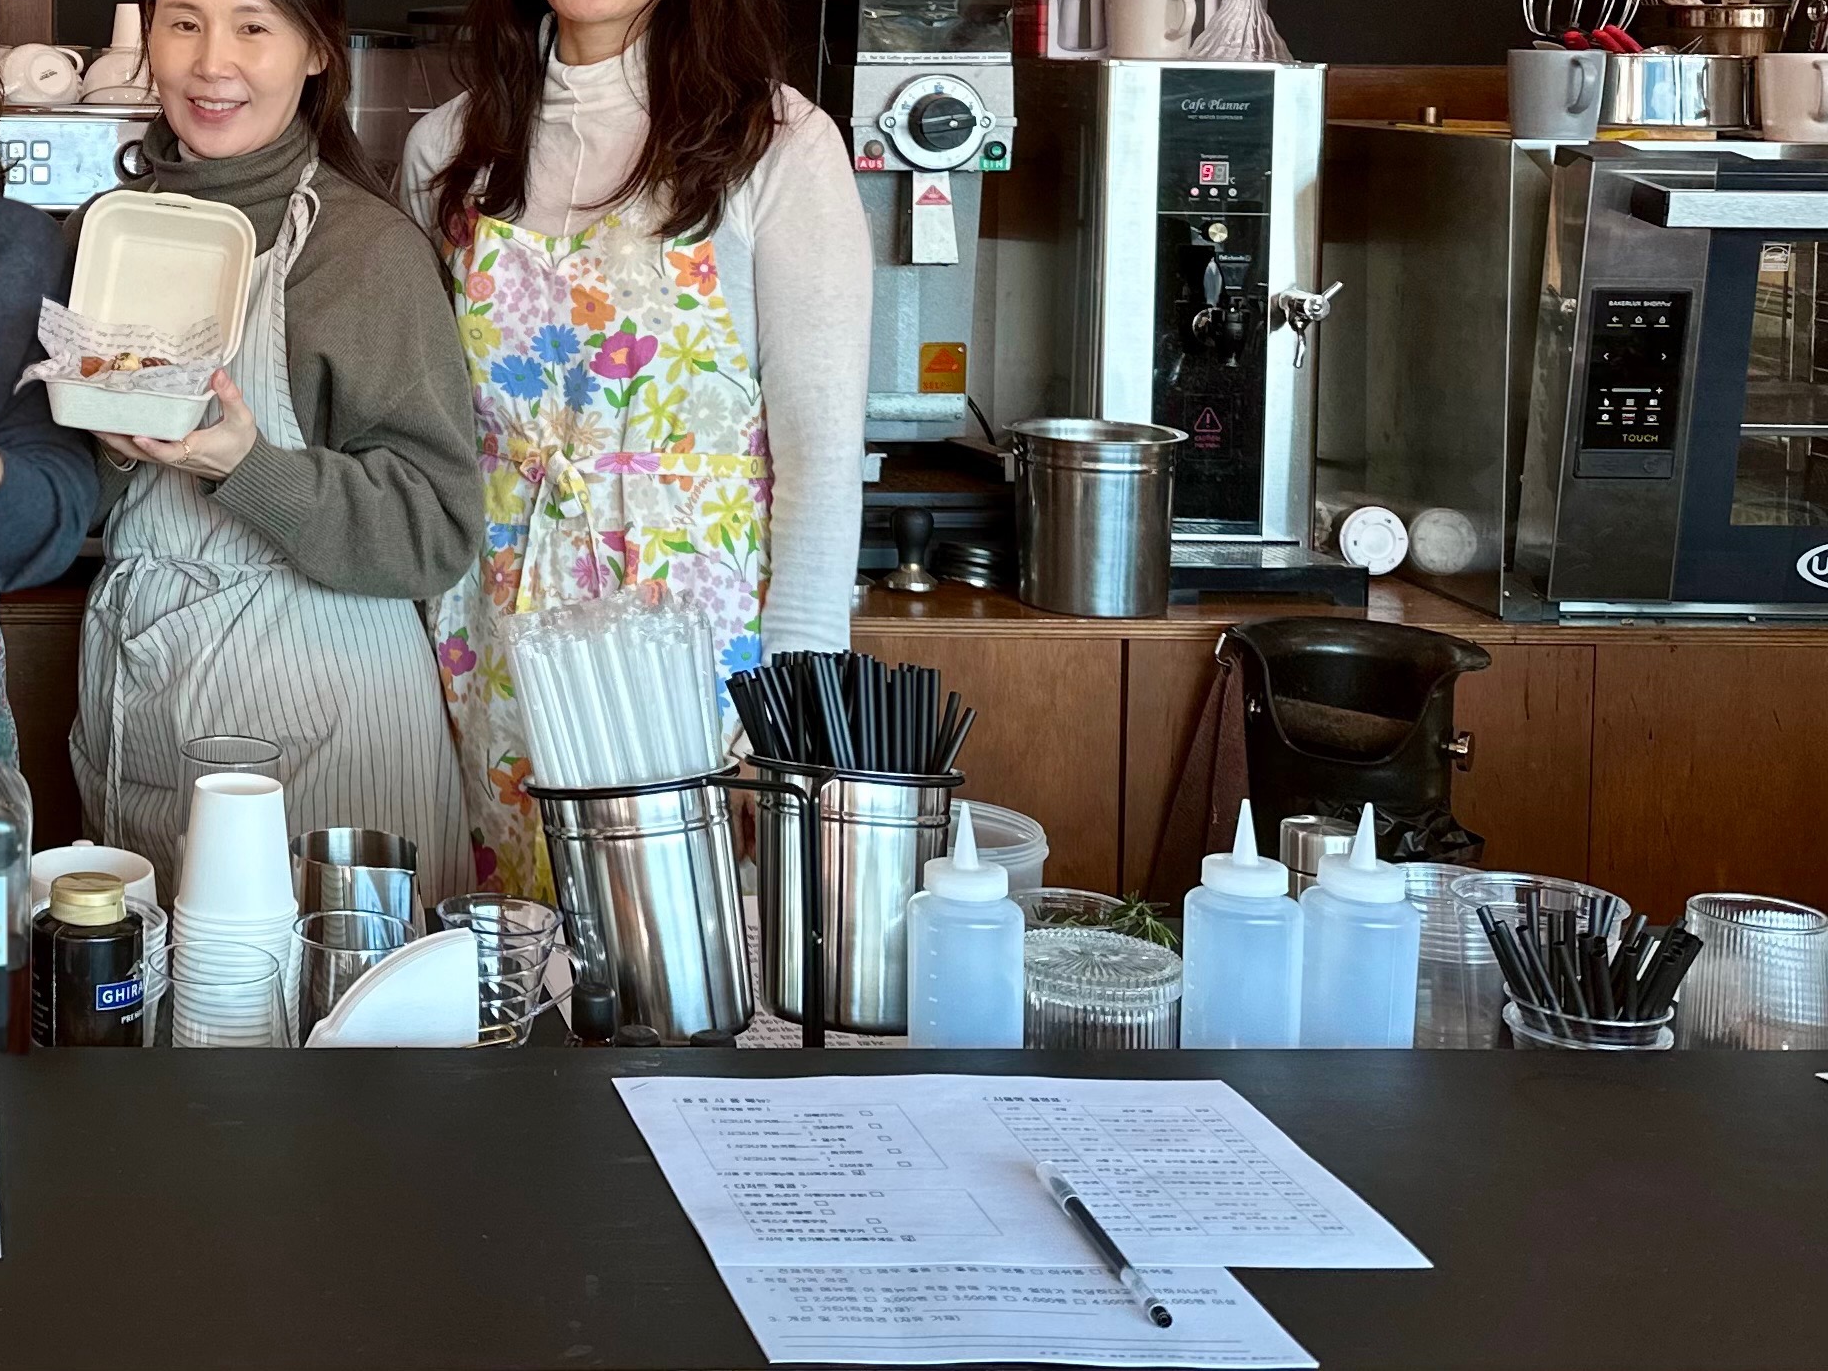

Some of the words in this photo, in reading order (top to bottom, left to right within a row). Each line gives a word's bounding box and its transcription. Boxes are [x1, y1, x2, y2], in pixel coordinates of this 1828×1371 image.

[1181, 98, 1206, 113] Cafe
[1208, 97, 1250, 111] Planner
[860, 159, 883, 169] AUS
[982, 159, 1004, 169] EIN
[1622, 433, 1659, 442] TOUCH
